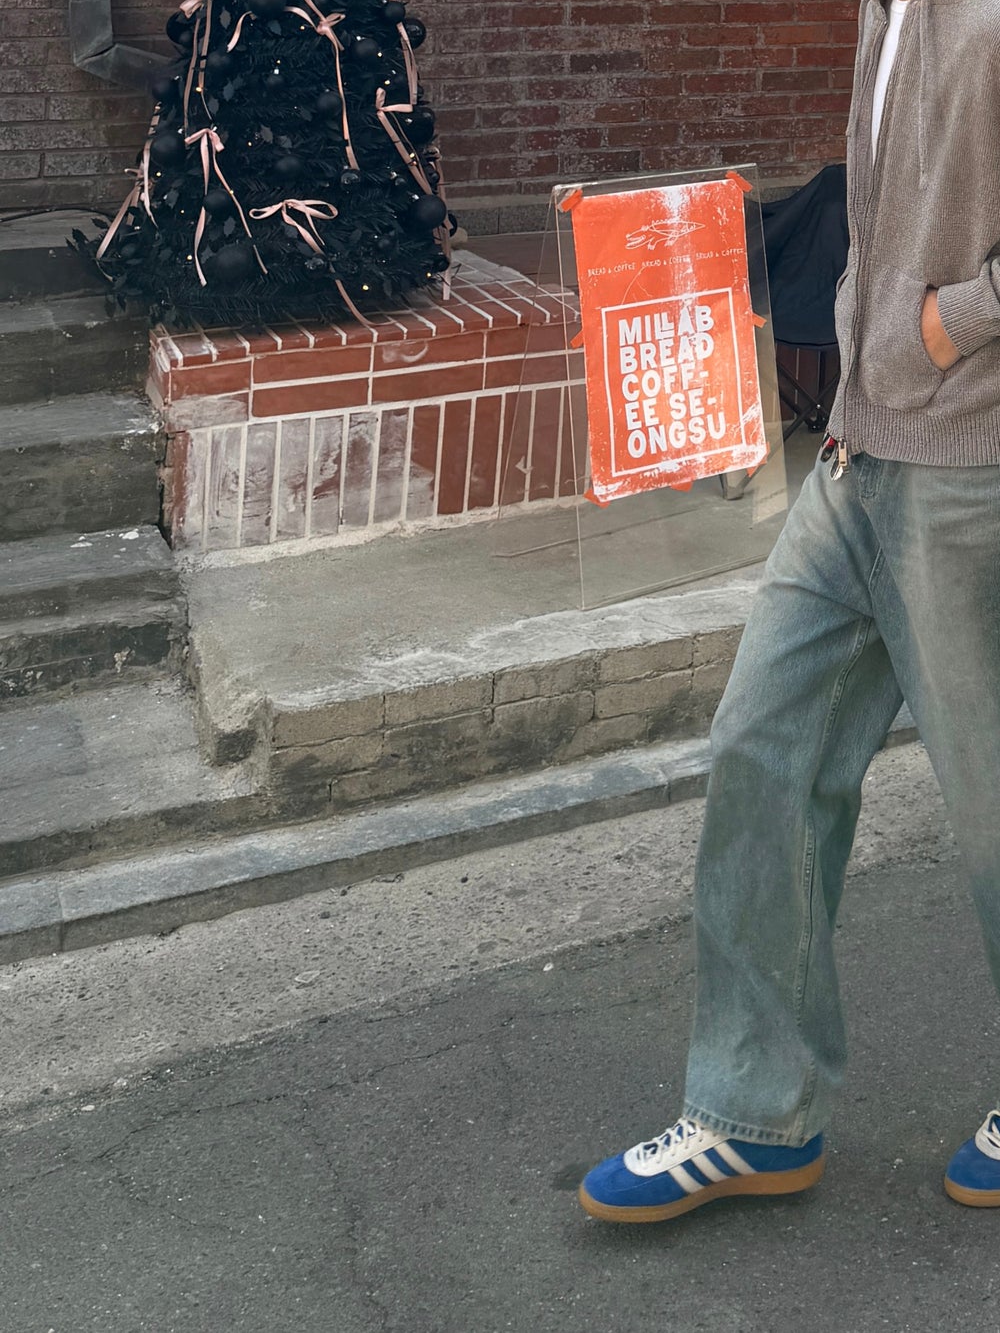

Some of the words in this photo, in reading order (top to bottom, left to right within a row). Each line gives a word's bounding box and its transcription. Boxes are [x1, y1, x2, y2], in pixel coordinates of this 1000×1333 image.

[618, 305, 714, 347] MILLAB
[619, 332, 714, 375] BREAD
[621, 362, 709, 402] COFF-
[624, 397, 660, 431] EE
[669, 388, 717, 421] SE-
[627, 411, 726, 459] ONGSU
